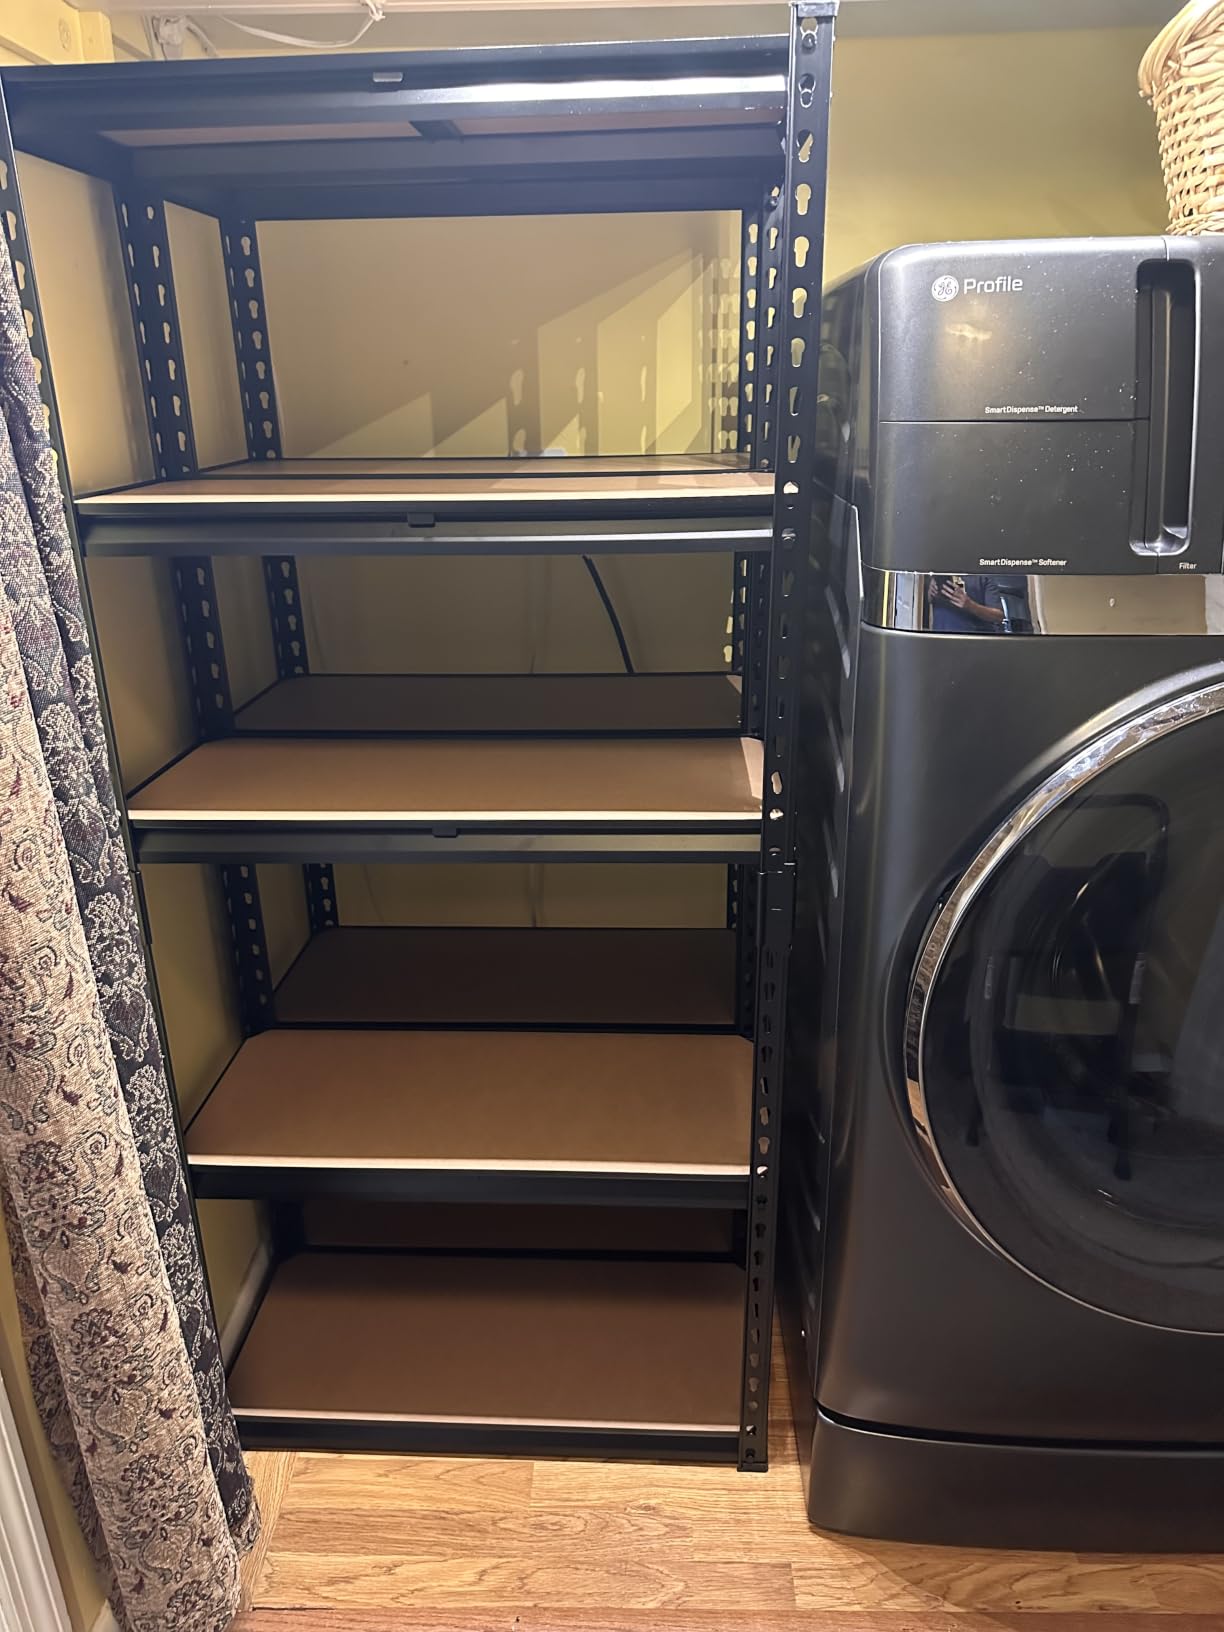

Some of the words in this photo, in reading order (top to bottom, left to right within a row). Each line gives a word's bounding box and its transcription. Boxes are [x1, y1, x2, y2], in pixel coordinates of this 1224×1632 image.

[963, 275, 1023, 294] Profile
[1044, 405, 1078, 414] Detergent
[1038, 558, 1067, 566] Softener
